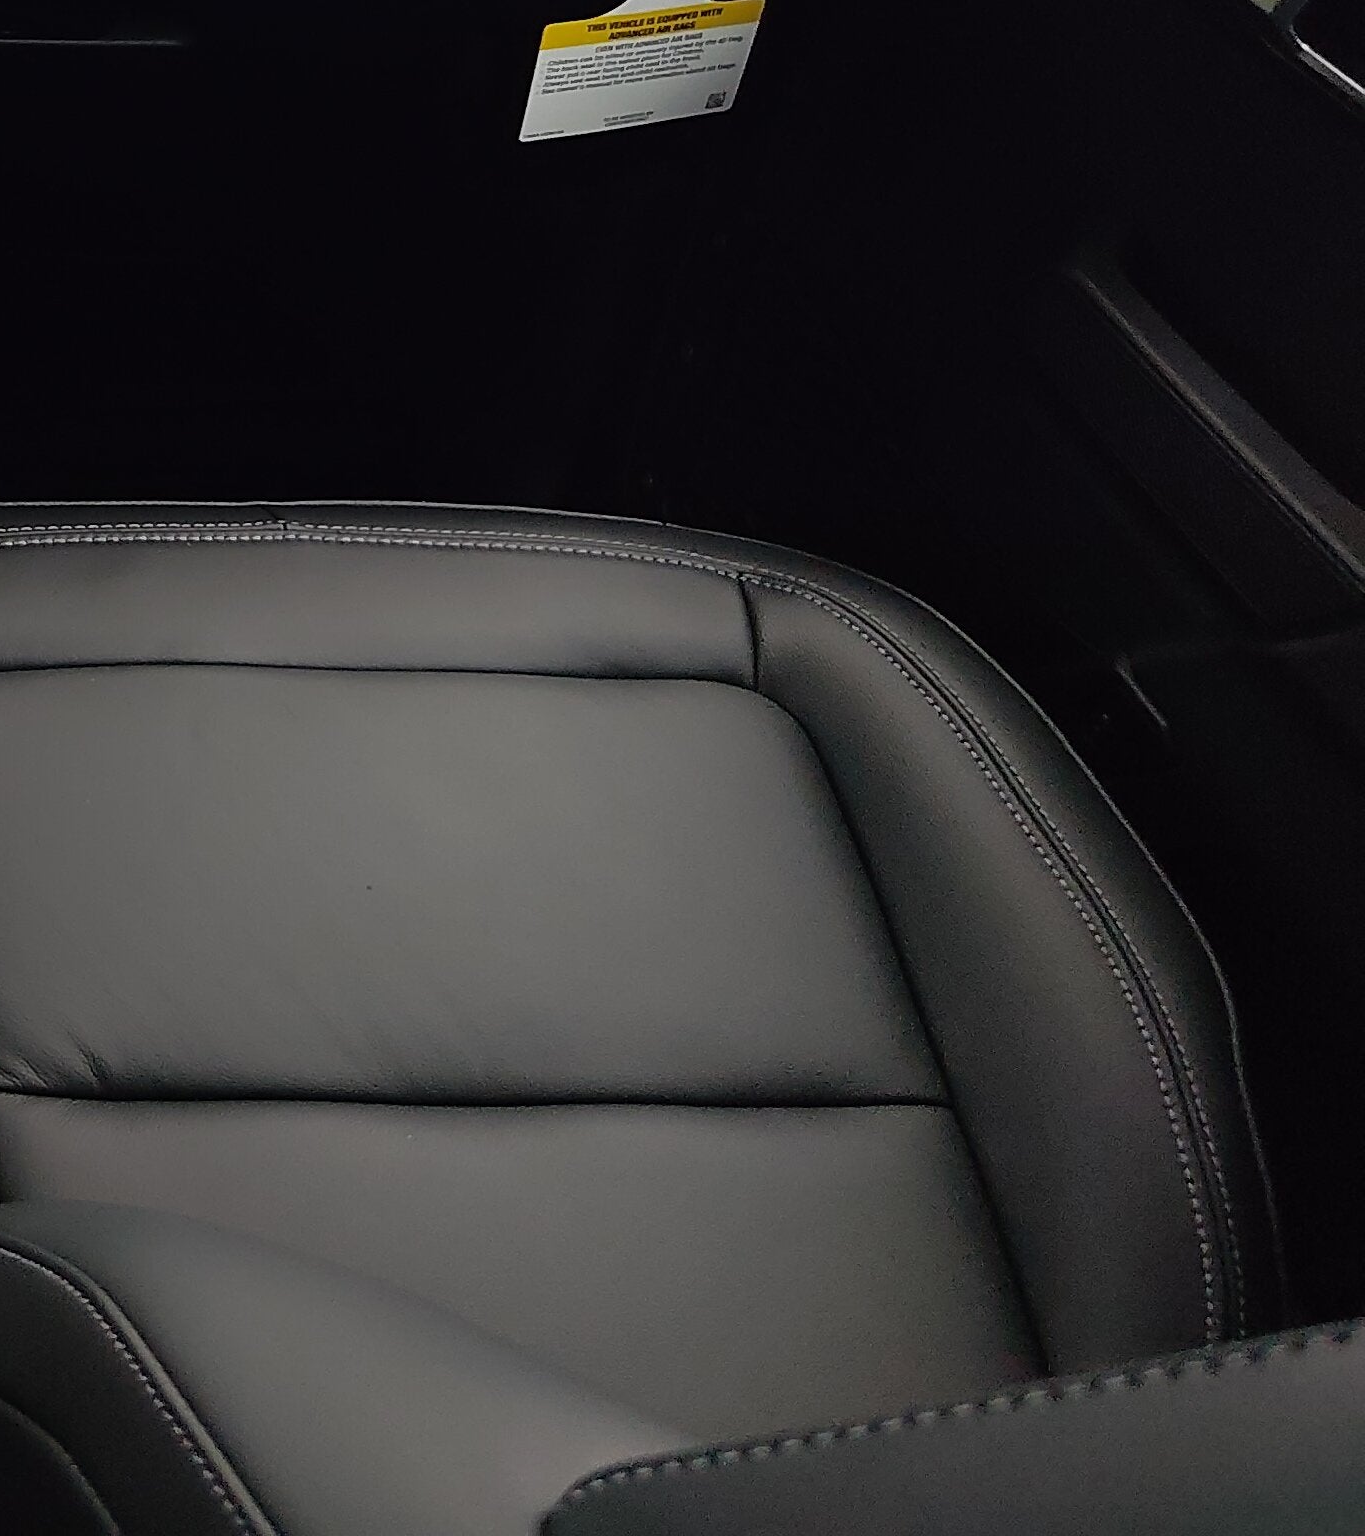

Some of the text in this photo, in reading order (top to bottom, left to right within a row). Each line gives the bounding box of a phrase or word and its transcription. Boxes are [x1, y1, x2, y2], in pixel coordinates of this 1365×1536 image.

[587, 7, 724, 32] THIS VEHICLE IS EQUIPPED WITH
[656, 24, 671, 33] AIR
[673, 21, 697, 32] BAGS
